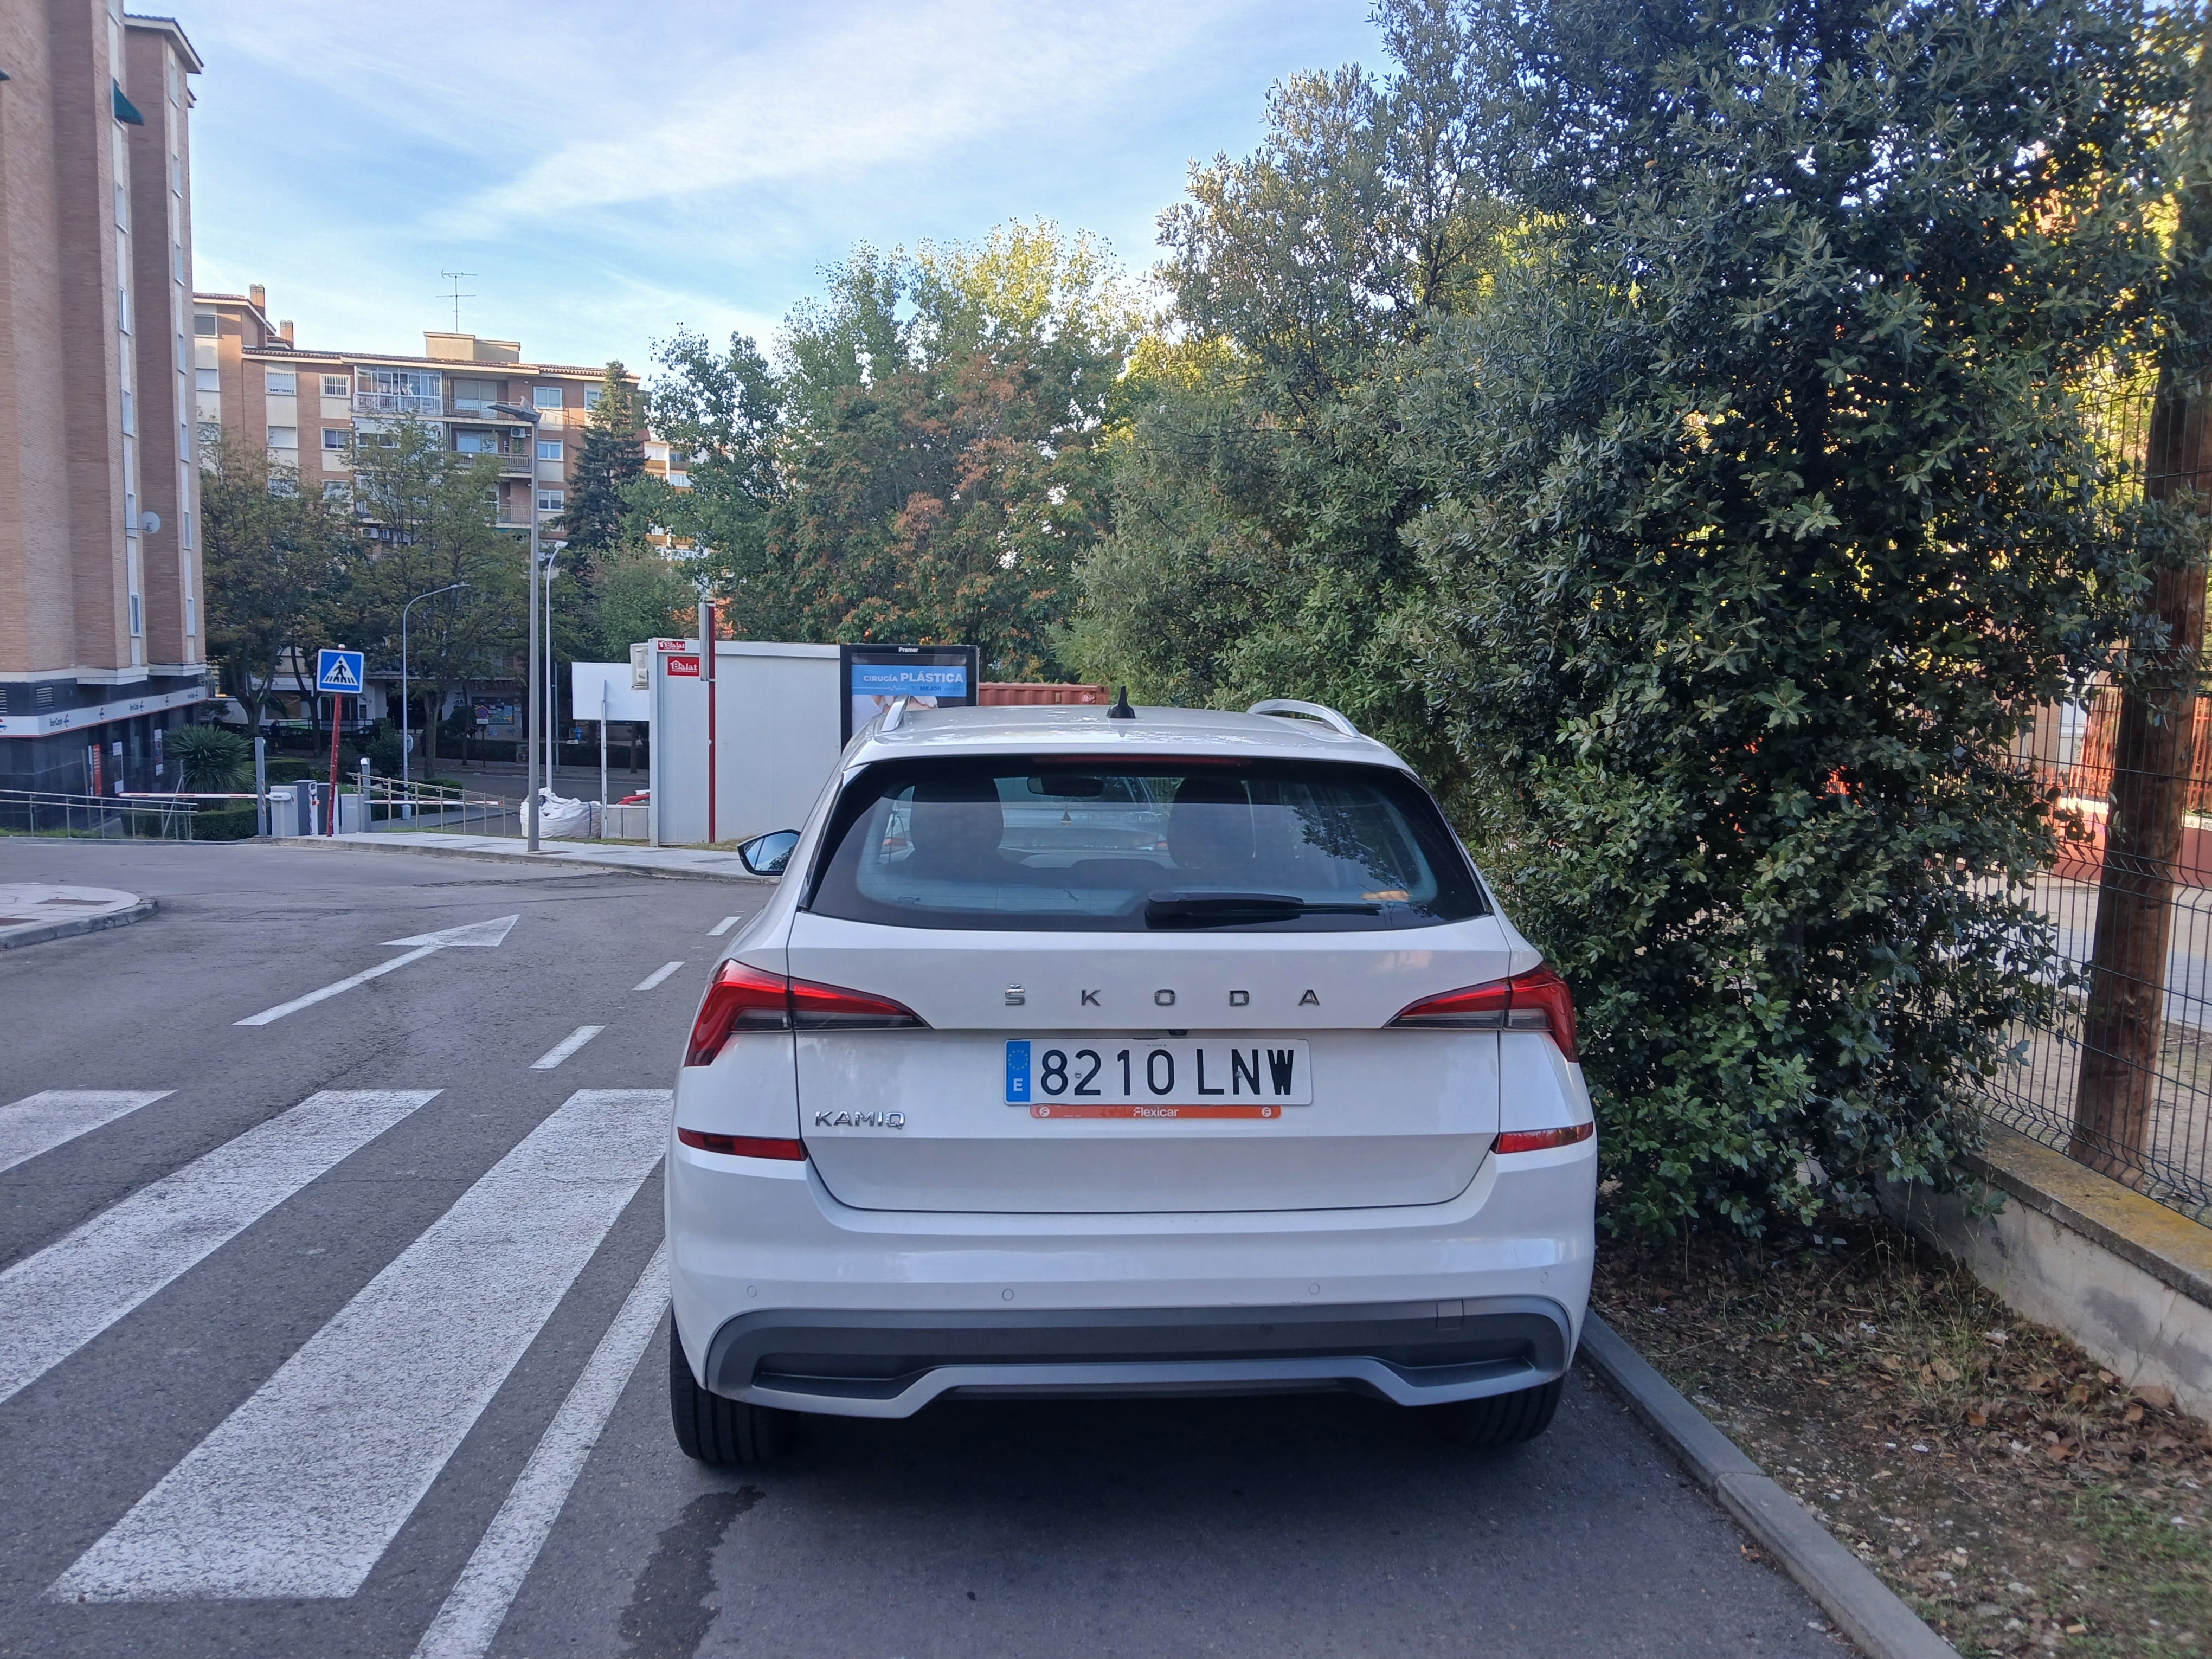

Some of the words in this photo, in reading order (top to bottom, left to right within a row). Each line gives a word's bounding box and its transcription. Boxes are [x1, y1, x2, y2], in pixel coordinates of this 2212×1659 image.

[672, 661, 698, 670] Balat
[901, 671, 964, 683] PLÁSTICA
[1005, 984, 1320, 1006] ŠKODA
[1040, 1049, 1174, 1096] 8210
[1196, 1049, 1295, 1096] LNW
[1013, 1078, 1024, 1092] E
[1133, 1107, 1179, 1117] Flexicar
[815, 1111, 905, 1129] KAMIQ
